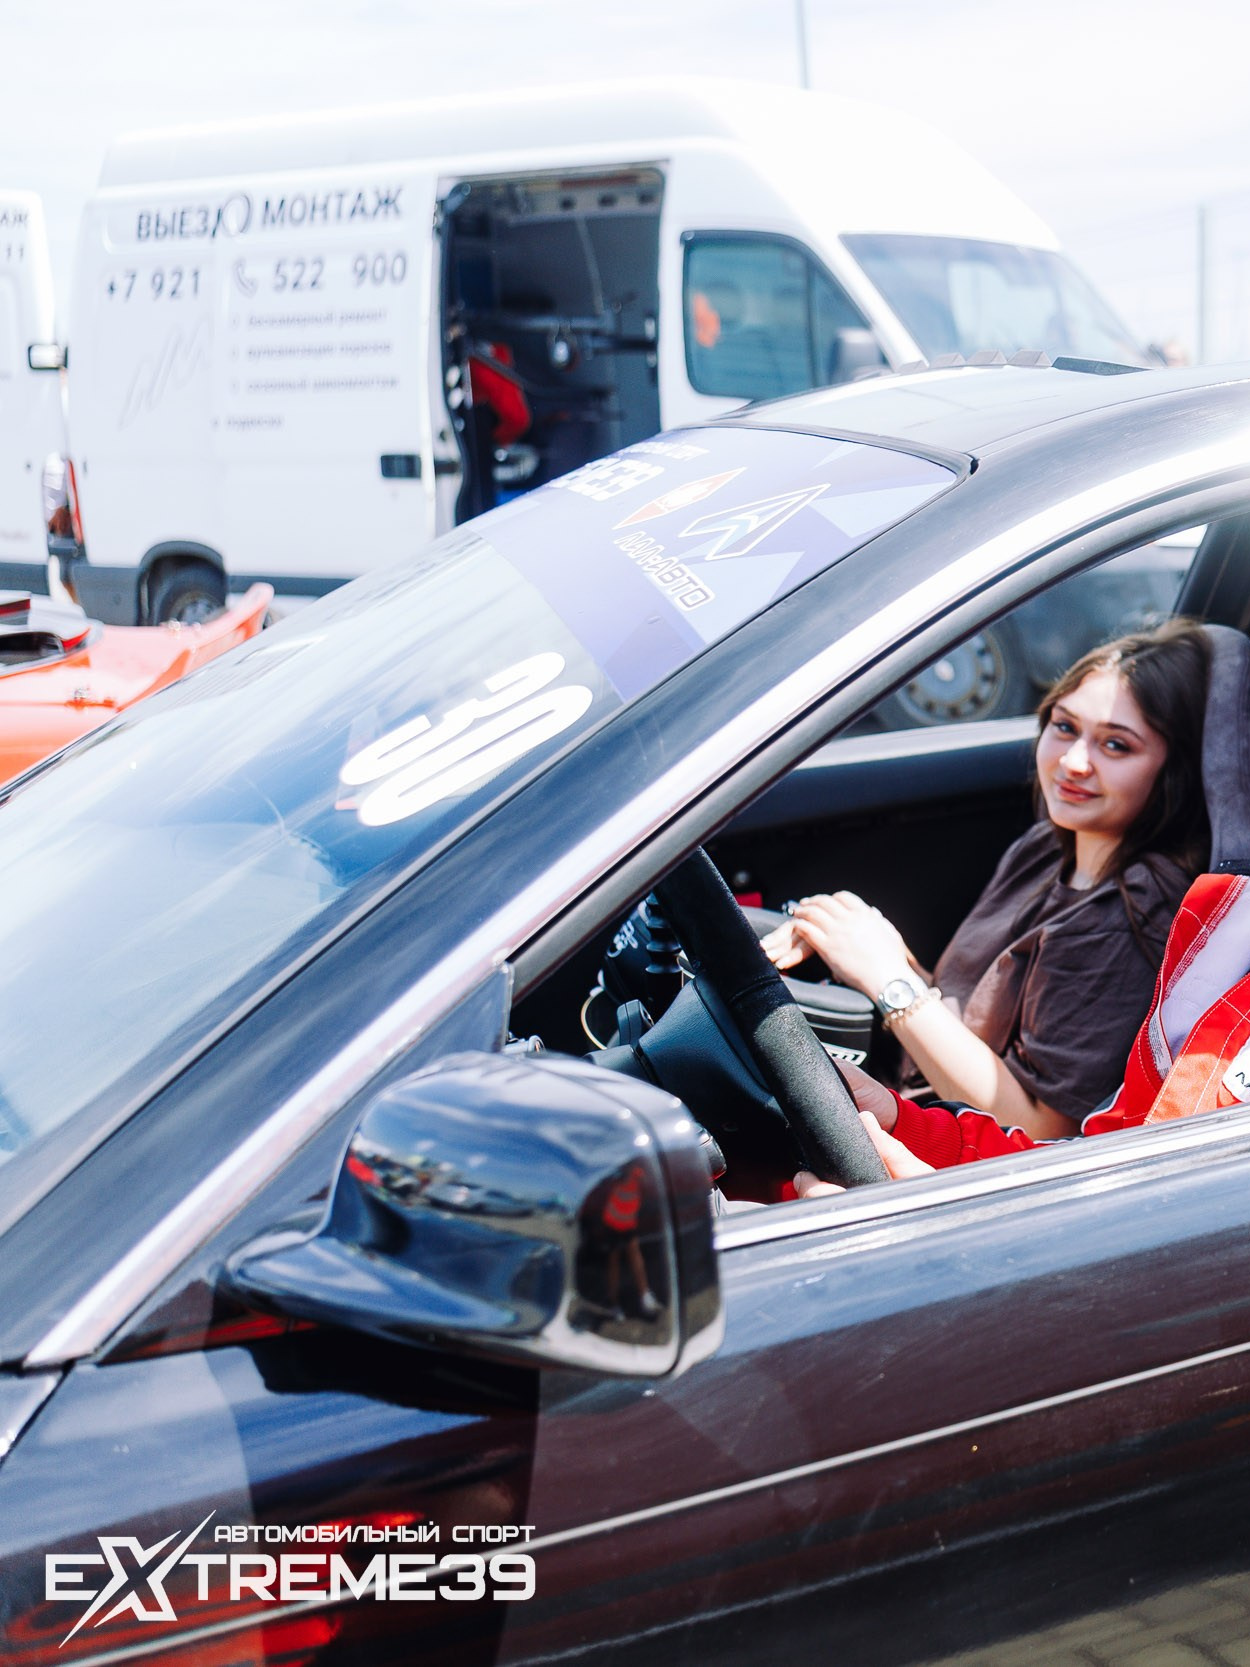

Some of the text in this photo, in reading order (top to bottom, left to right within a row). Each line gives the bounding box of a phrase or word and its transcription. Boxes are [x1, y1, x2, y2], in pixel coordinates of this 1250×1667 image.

[262, 186, 403, 228] МОНТАЖ
[151, 264, 201, 300] 921
[273, 257, 326, 293] 522
[353, 249, 408, 288] 900
[339, 651, 594, 827] 30
